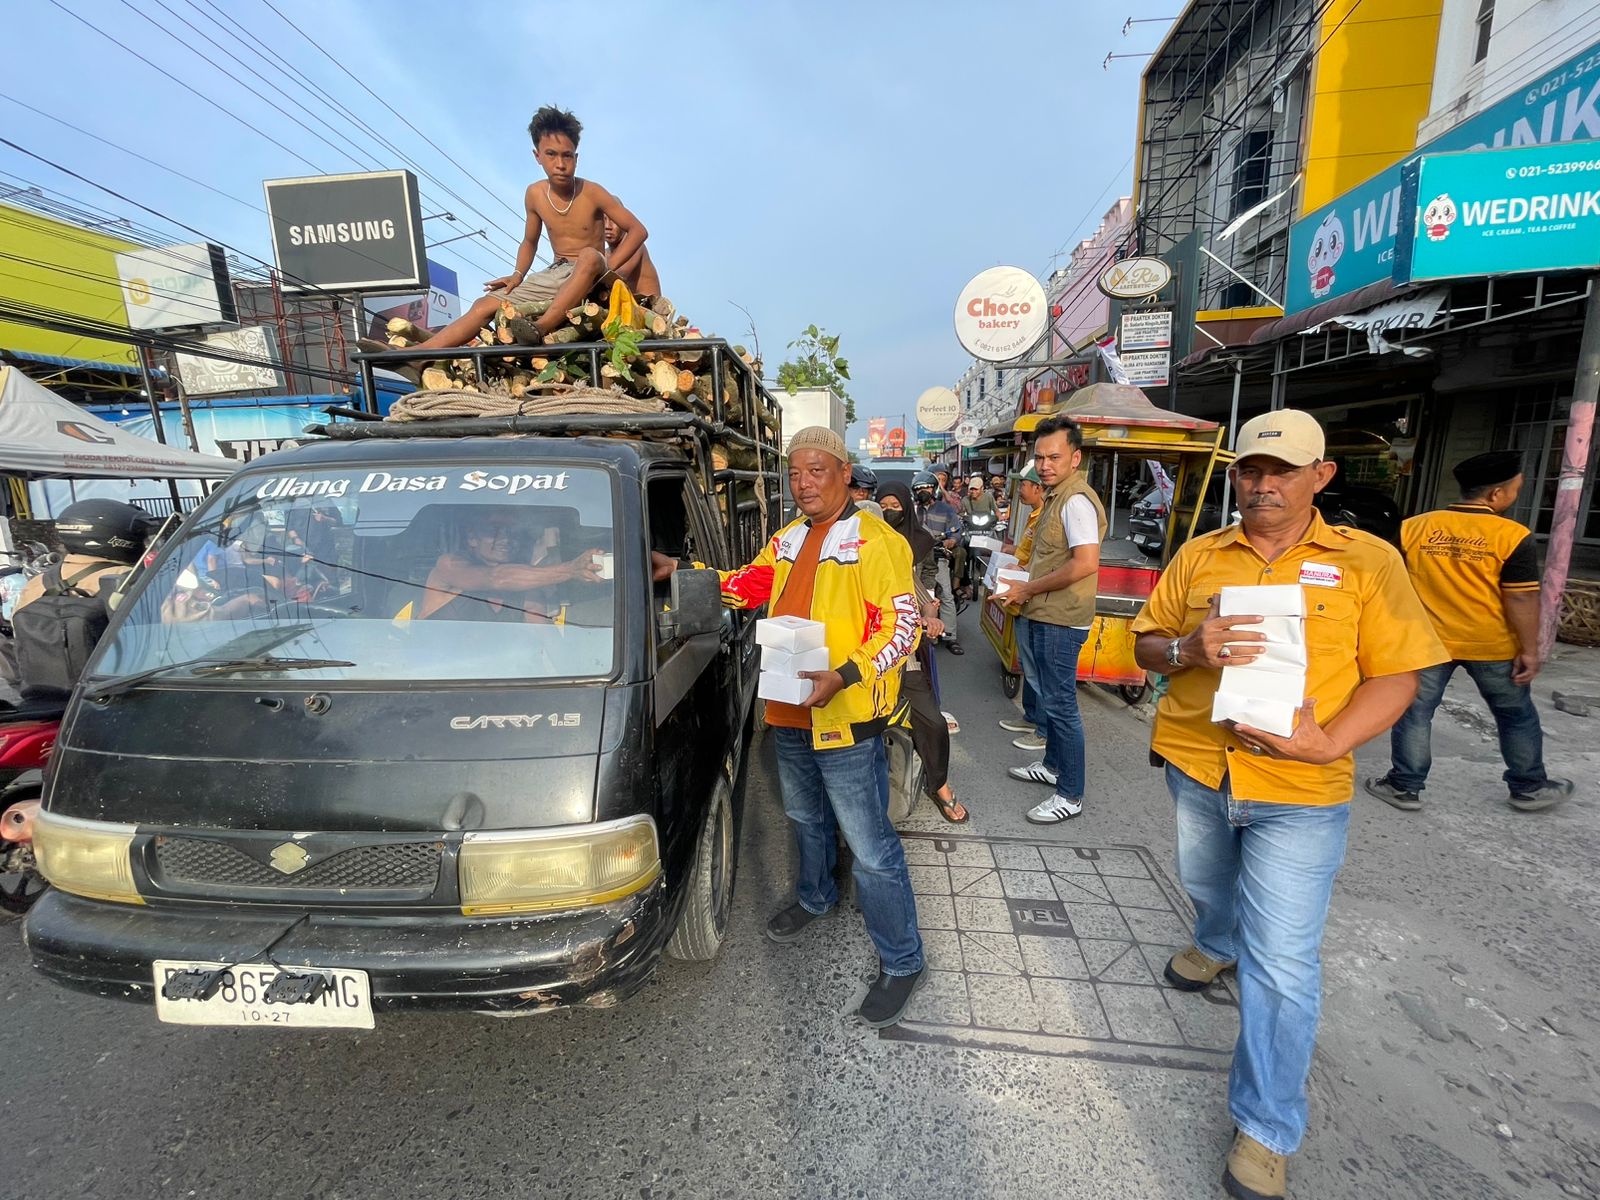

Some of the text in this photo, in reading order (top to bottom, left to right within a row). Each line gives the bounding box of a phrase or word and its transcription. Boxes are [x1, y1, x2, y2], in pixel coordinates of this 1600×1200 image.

[289, 219, 395, 246] SAMSUNG
[1481, 229, 1494, 237] ICE
[967, 297, 1032, 317] Choco
[978, 320, 1020, 329] bakery
[213, 374, 239, 383] TITO
[231, 439, 300, 462] TIT
[256, 469, 570, 498] Ulang Dasa Sopat
[1428, 530, 1487, 547] Junaidi
[450, 712, 581, 729] CARRY 1.5
